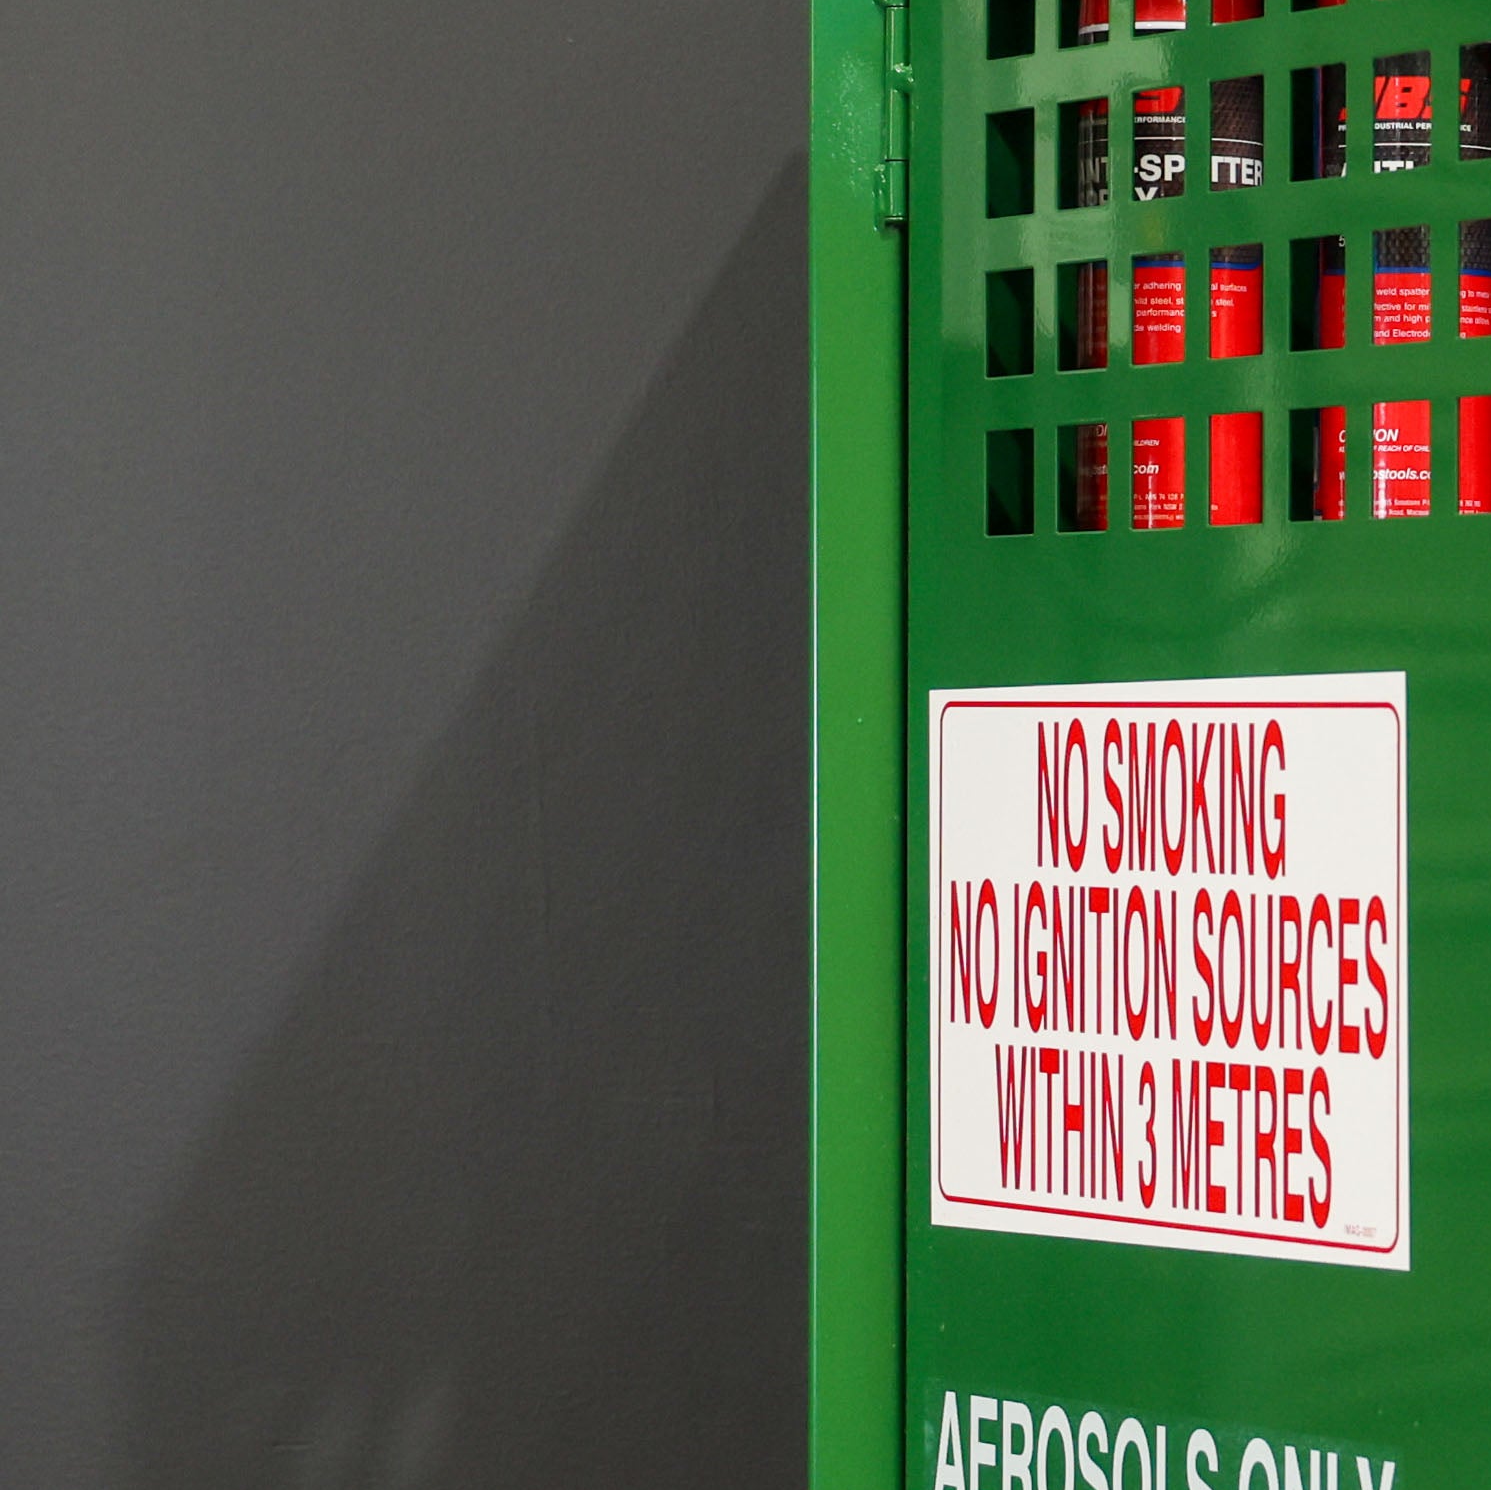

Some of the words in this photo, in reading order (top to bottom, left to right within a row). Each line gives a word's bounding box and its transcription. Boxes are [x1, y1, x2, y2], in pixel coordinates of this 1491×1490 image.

[1038, 718, 1088, 873] NO
[1103, 718, 1286, 880] SMOKING
[950, 878, 1000, 1030] NO
[1014, 880, 1177, 1042] IGNITION
[1192, 888, 1388, 1060] SOURCES
[995, 1043, 1124, 1202] WITHIN
[1138, 1061, 1157, 1209] 3
[1172, 1058, 1332, 1229] METRES
